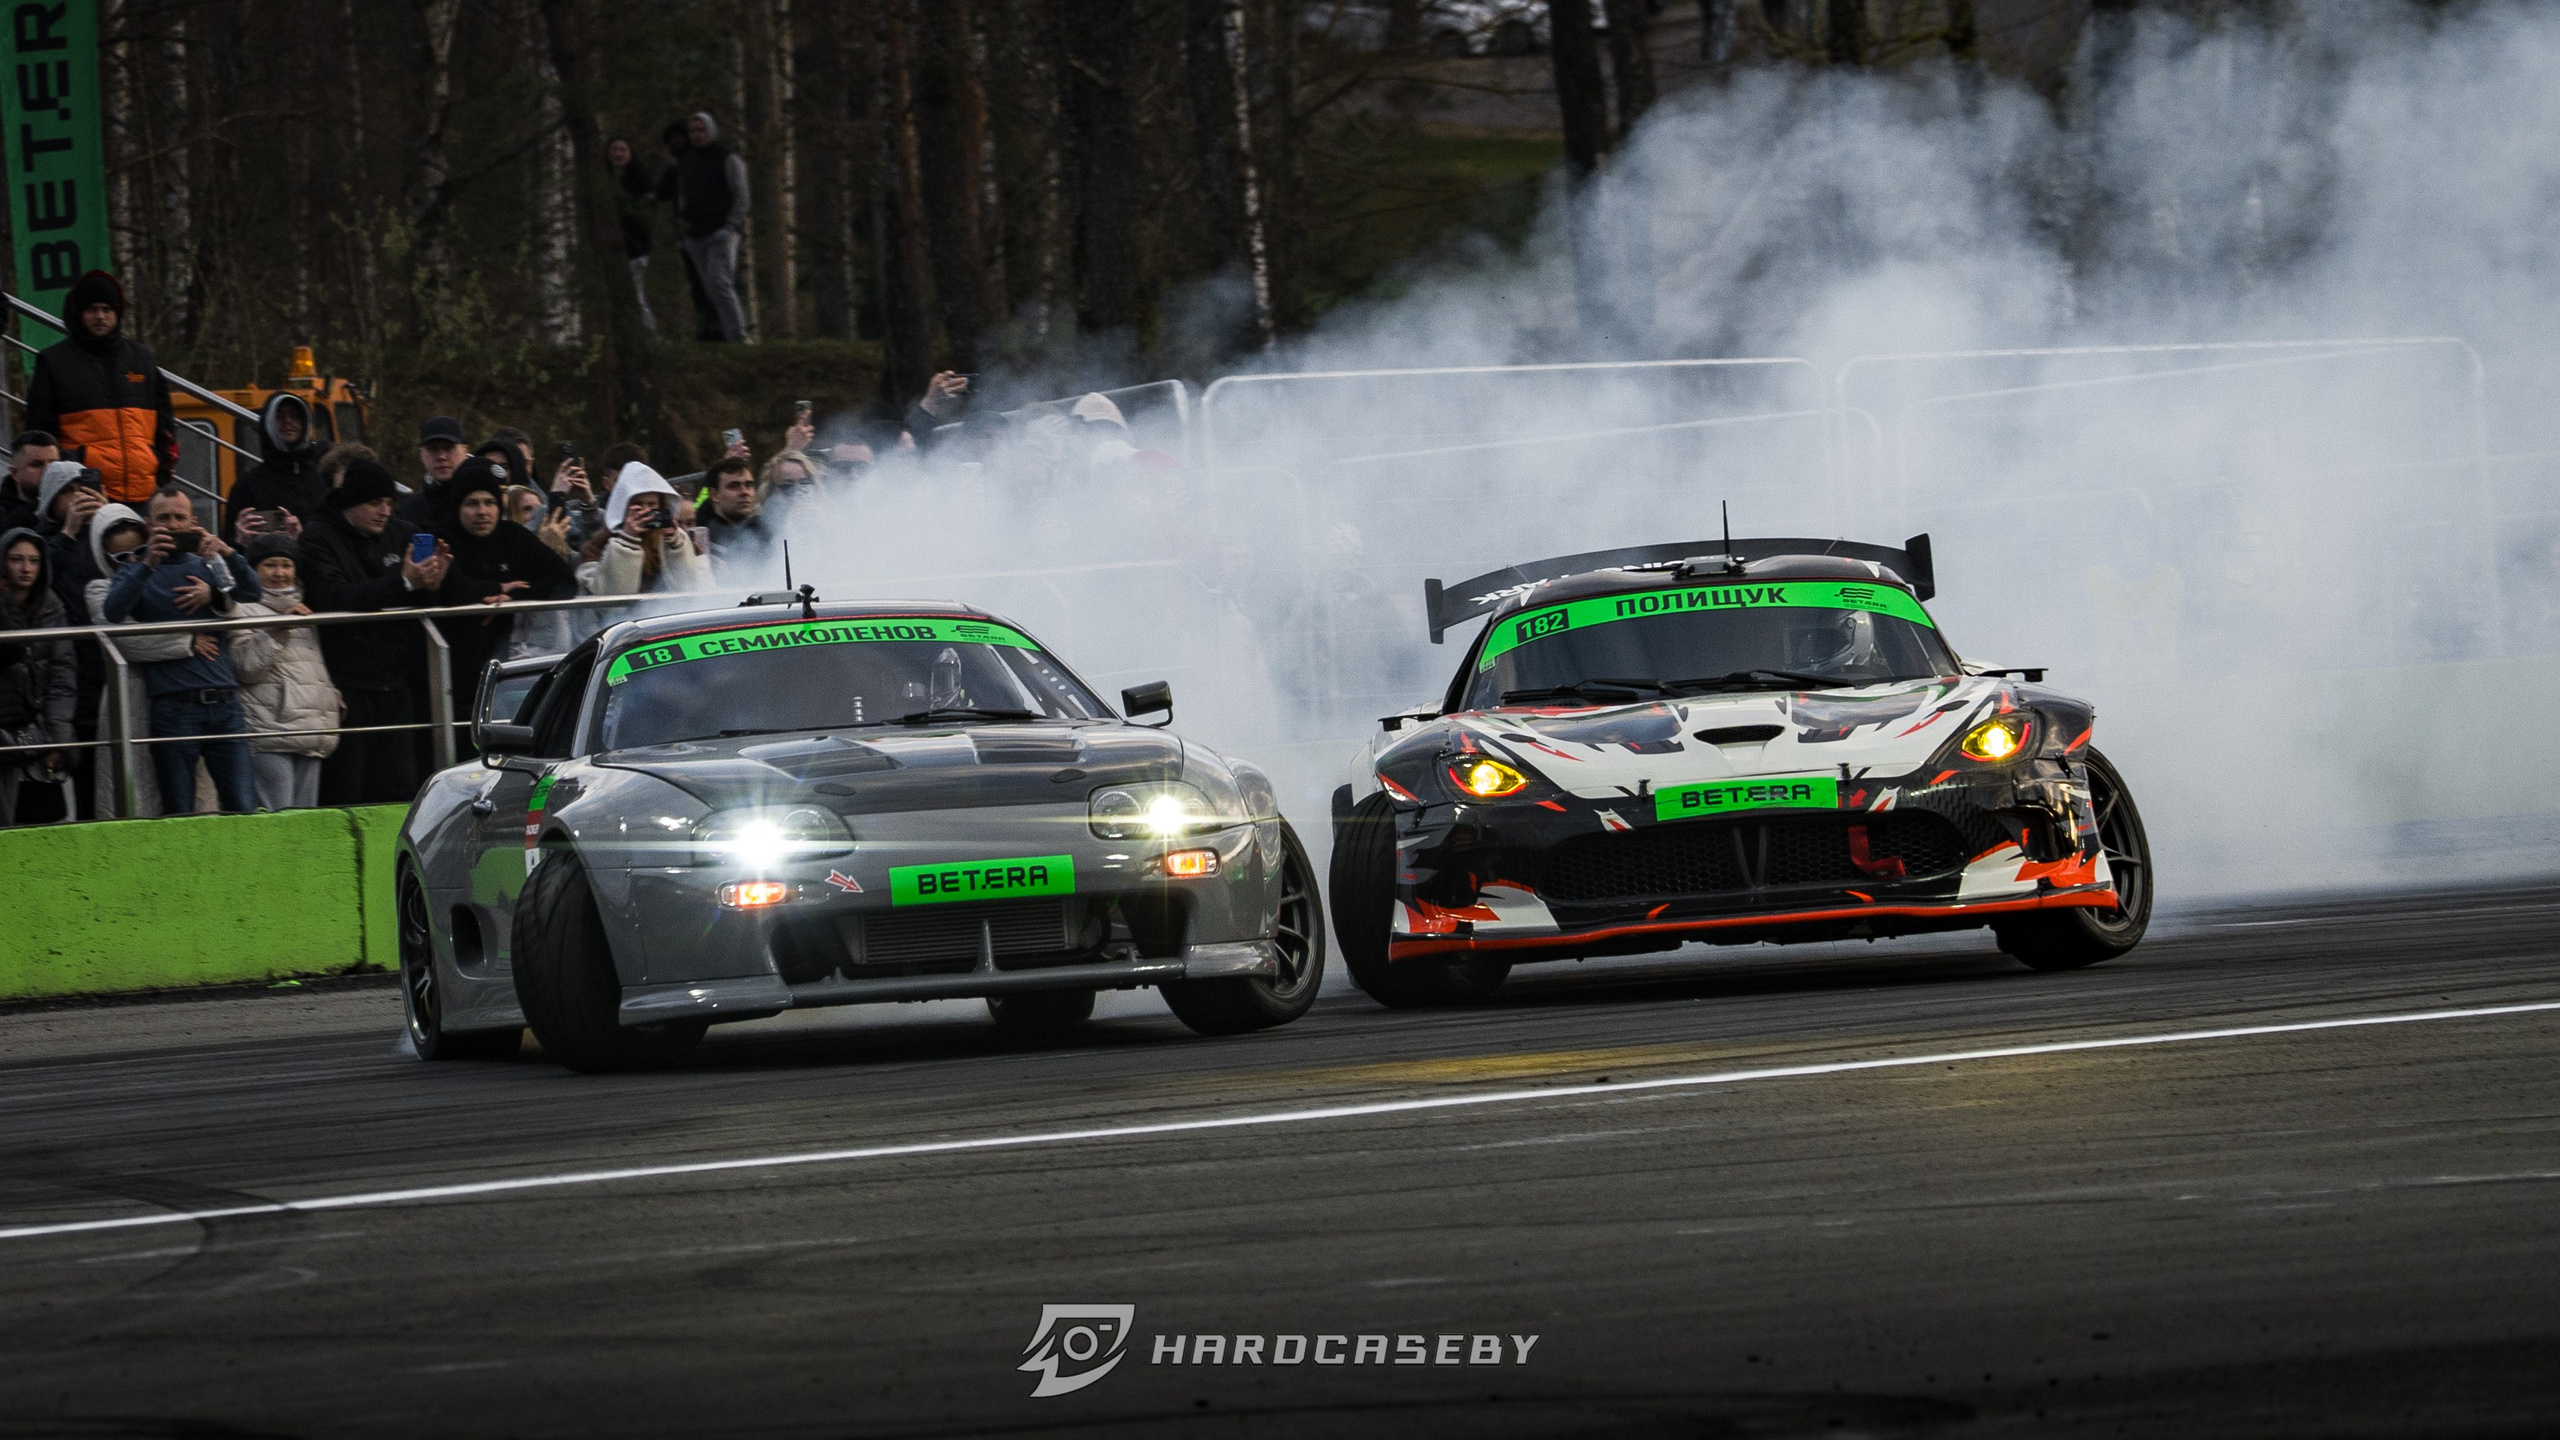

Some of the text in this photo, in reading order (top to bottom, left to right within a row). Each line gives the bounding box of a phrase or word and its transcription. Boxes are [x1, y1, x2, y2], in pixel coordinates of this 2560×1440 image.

[1521, 587, 1788, 638] 182 ПОЛИЩУК
[639, 625, 938, 665] 18 СЕМИКОЛЕНОВ
